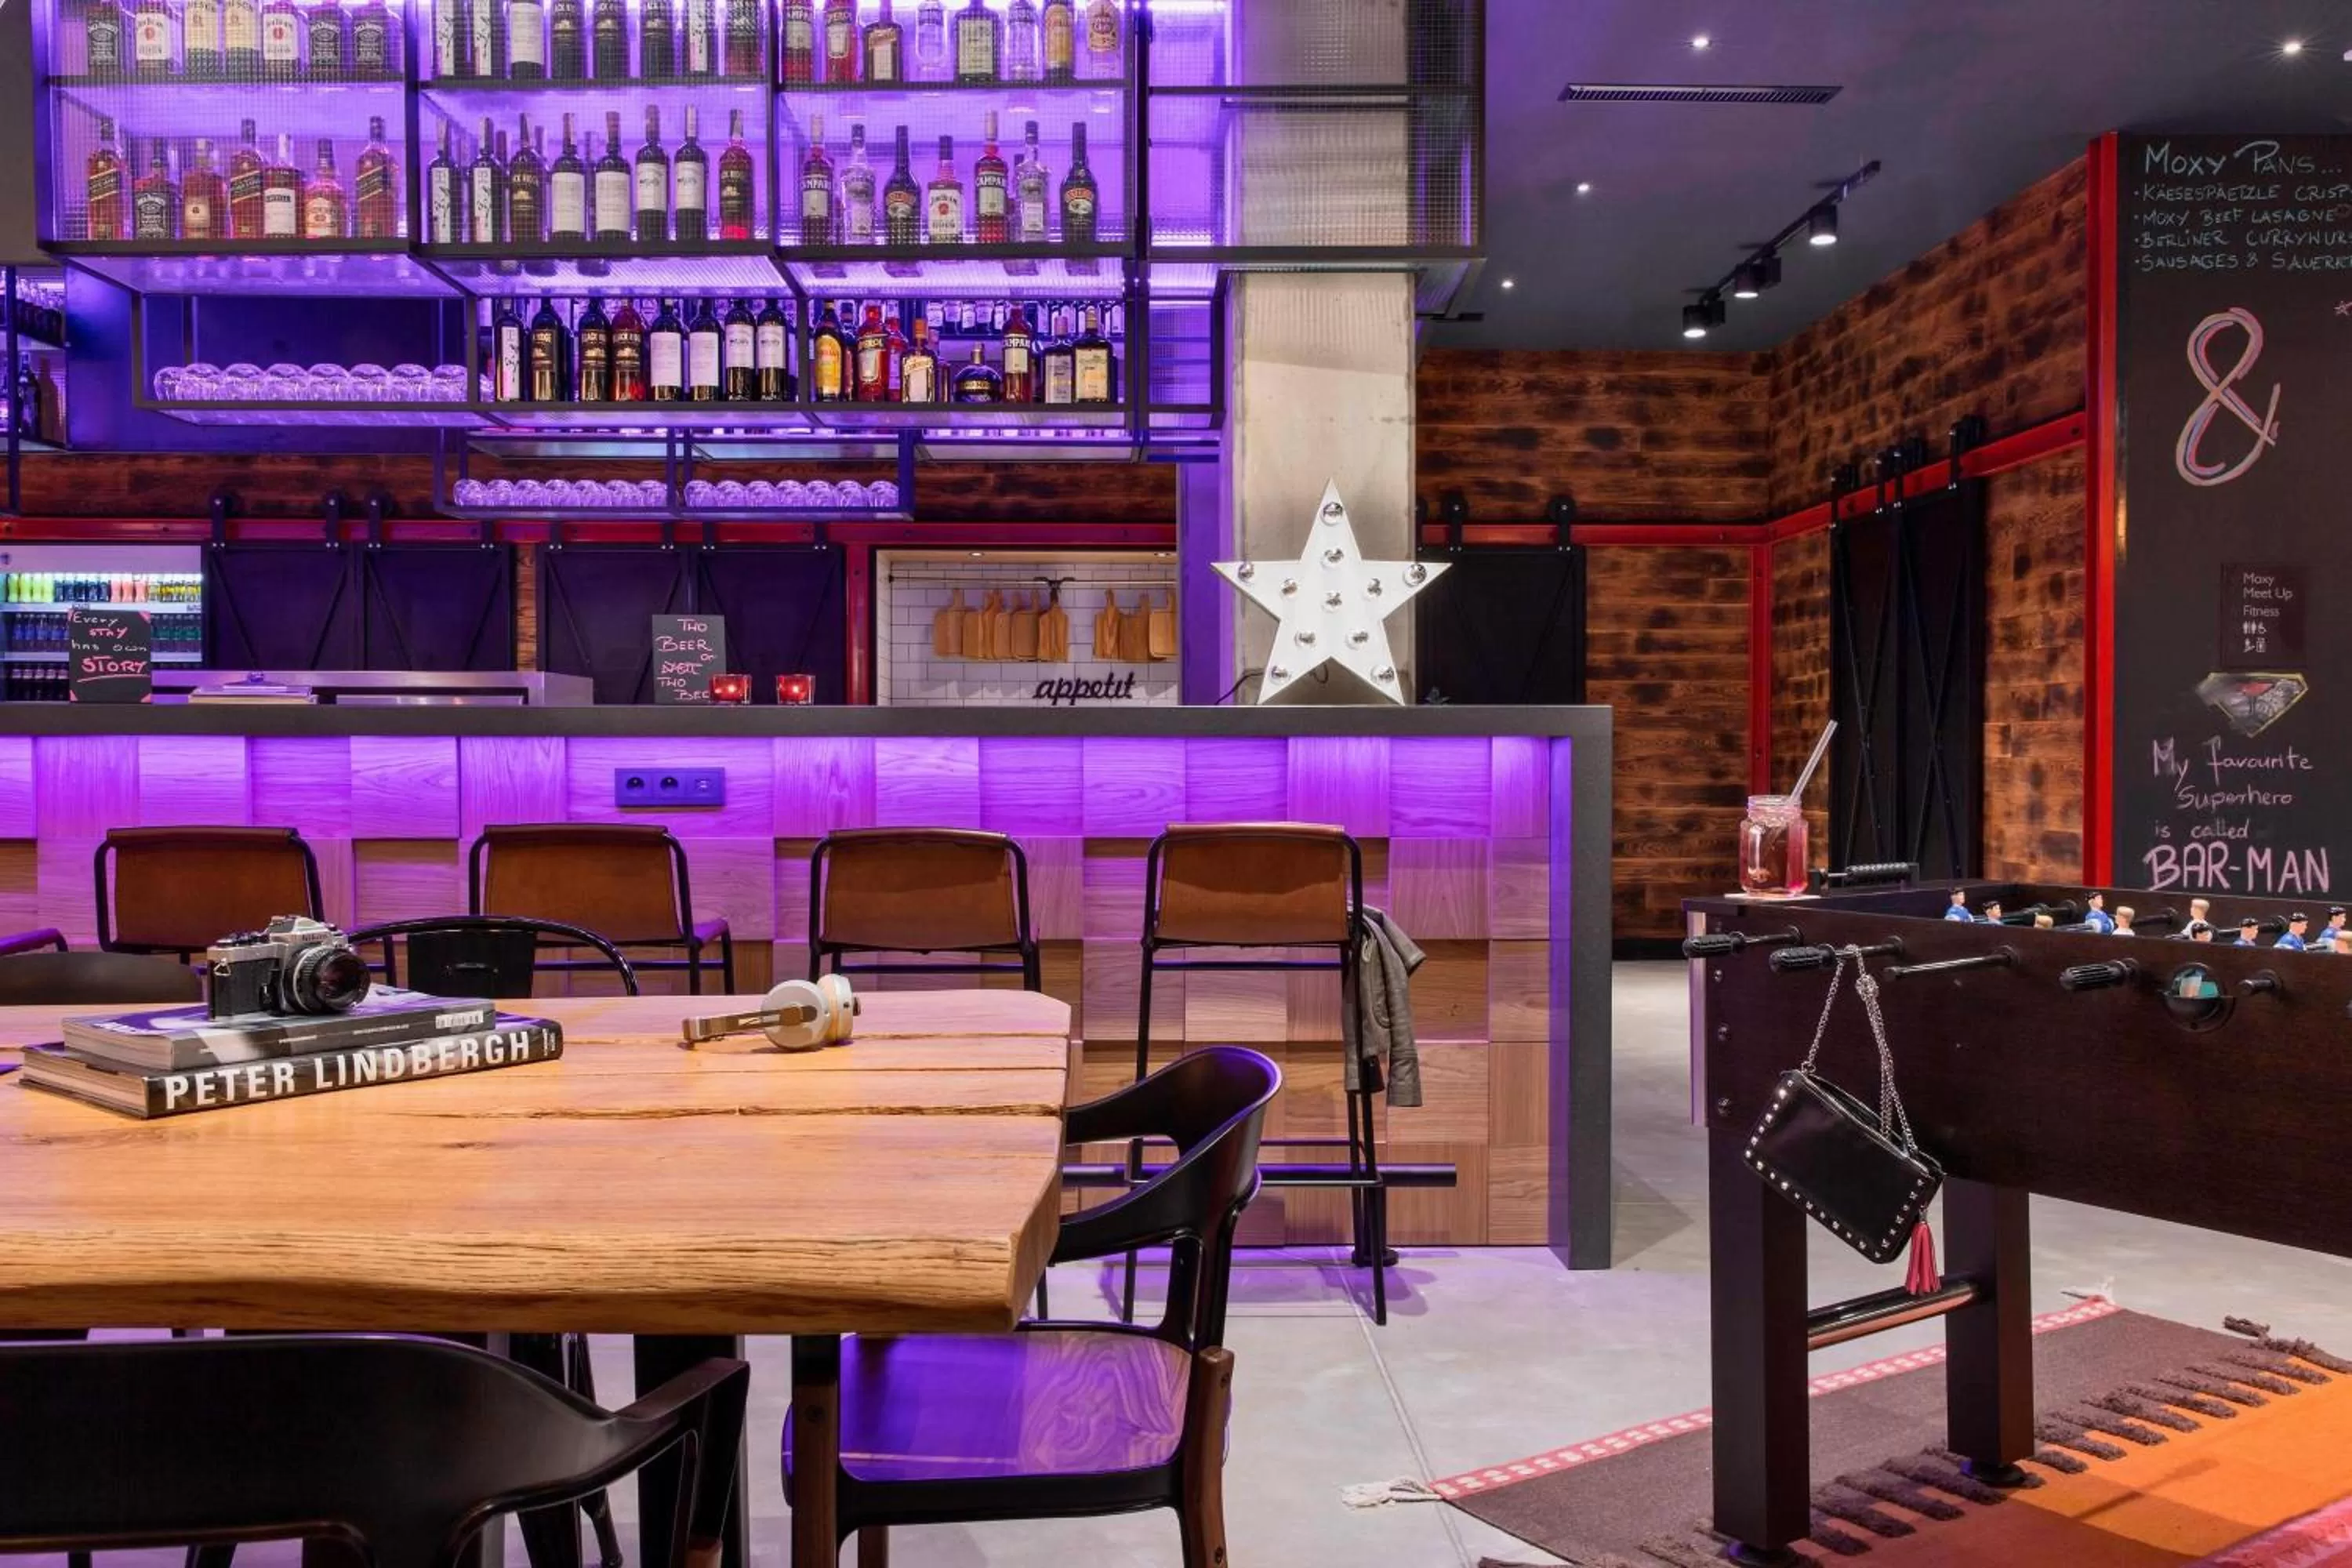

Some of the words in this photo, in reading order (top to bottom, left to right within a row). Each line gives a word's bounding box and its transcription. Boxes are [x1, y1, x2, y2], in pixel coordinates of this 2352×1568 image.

[2251, 209, 2334, 223] LASAGNE
[2141, 253, 2238, 272] SAUSAGES
[2176, 307, 2281, 486] &
[2243, 572, 2274, 586] Moxy
[2243, 589, 2272, 599] Meet
[2275, 588, 2292, 601] Up
[2243, 605, 2280, 616] Fitness
[655, 636, 713, 652] BEER
[82, 655, 147, 673] STORY
[1033, 672, 1135, 706] appetit
[2153, 737, 2188, 790] My
[2176, 785, 2292, 812] Superhero
[2155, 821, 2170, 837] is
[2191, 818, 2249, 838] called
[2143, 841, 2329, 895] BAR-MAN
[165, 1062, 295, 1109] PETER
[314, 1031, 529, 1090] LINDBERGH
